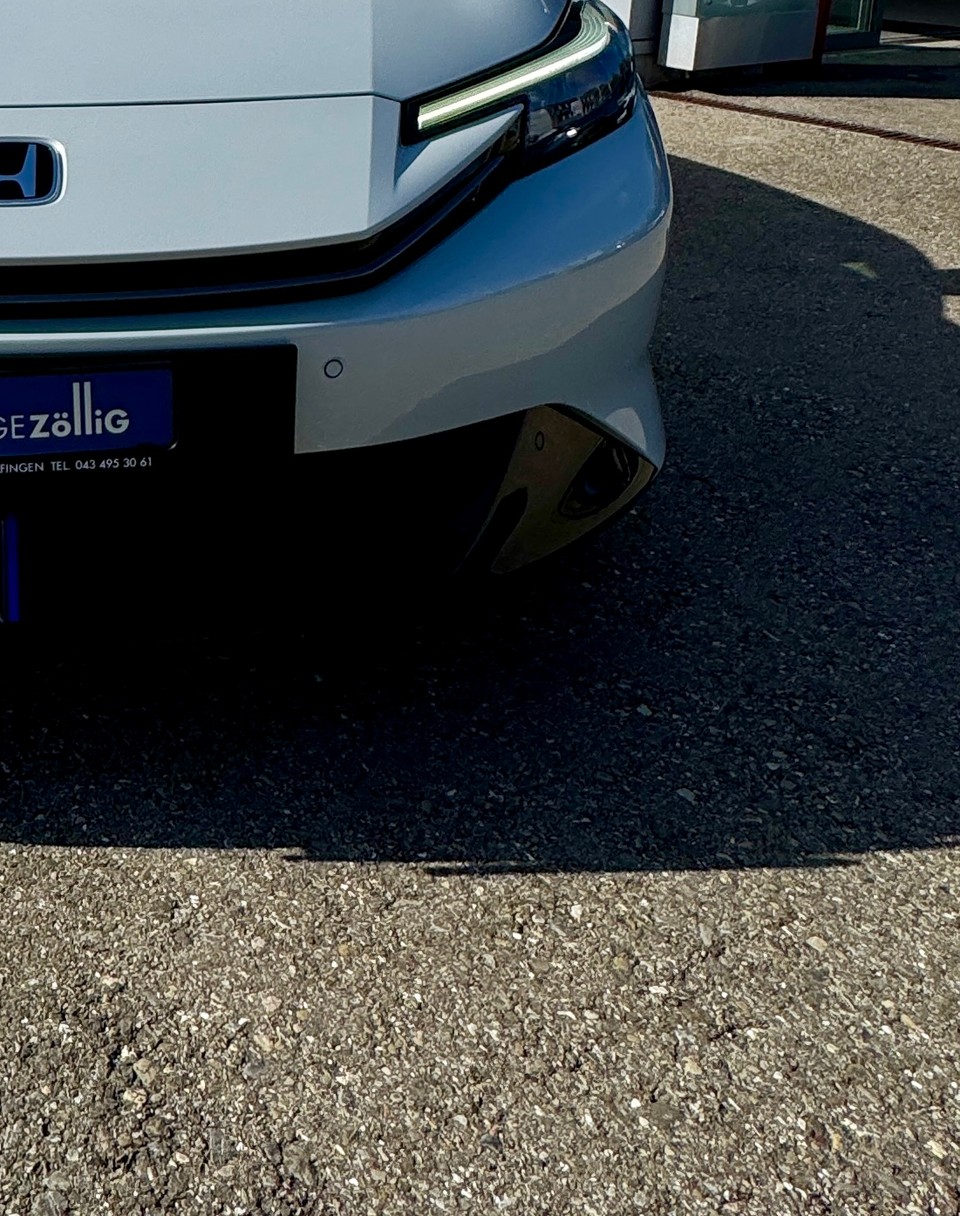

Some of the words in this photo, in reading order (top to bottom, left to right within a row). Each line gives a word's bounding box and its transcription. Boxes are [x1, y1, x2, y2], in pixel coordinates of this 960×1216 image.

[75, 459, 96, 470] 043
[99, 458, 120, 469] 495
[123, 457, 137, 468] 30
[139, 456, 152, 467] 61
